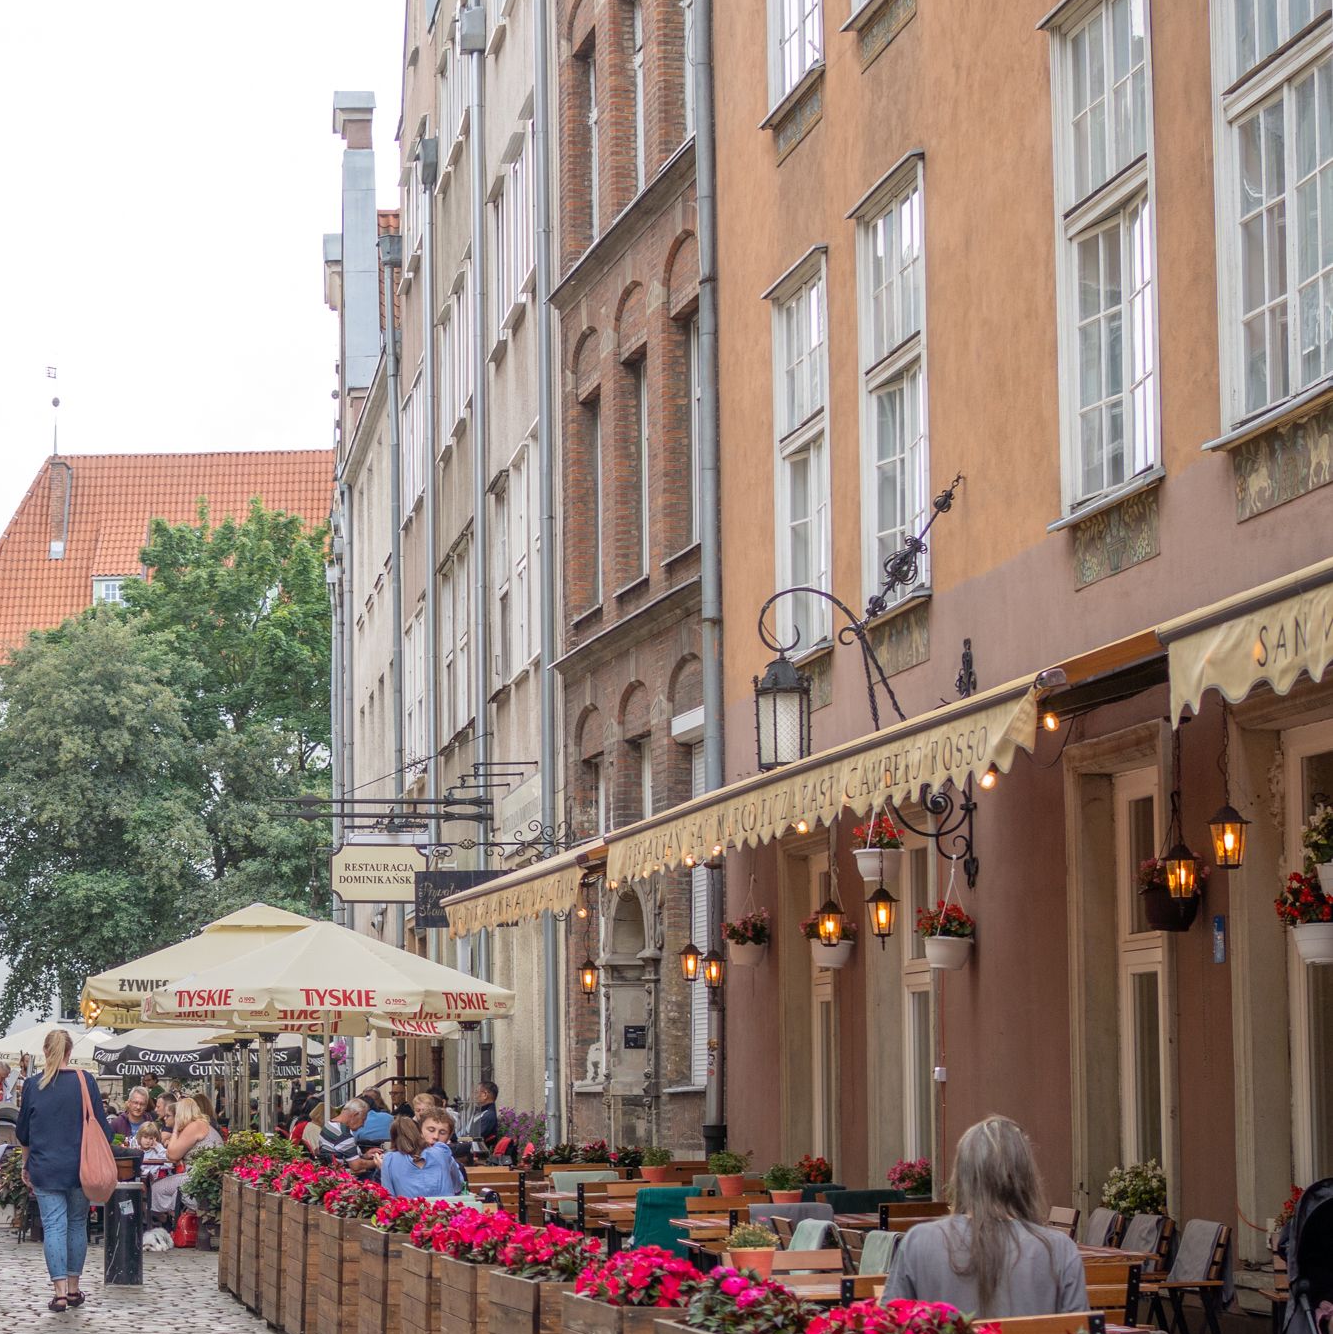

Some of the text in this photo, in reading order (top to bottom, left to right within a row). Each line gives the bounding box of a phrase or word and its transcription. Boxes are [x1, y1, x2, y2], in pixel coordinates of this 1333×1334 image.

[1257, 612, 1307, 667] SAN
[931, 726, 988, 775] ROSSO
[344, 862, 414, 872] RESTAURACJA
[339, 873, 415, 884] DOMINIKAŃSK
[176, 988, 234, 1008] TYSKIE
[300, 988, 377, 1008] TYSKIE
[442, 992, 490, 1011] TYSKIE
[389, 1017, 441, 1034] TYSKIE
[139, 1050, 201, 1064] GUINNESS
[116, 1062, 166, 1076] GUINNESS
